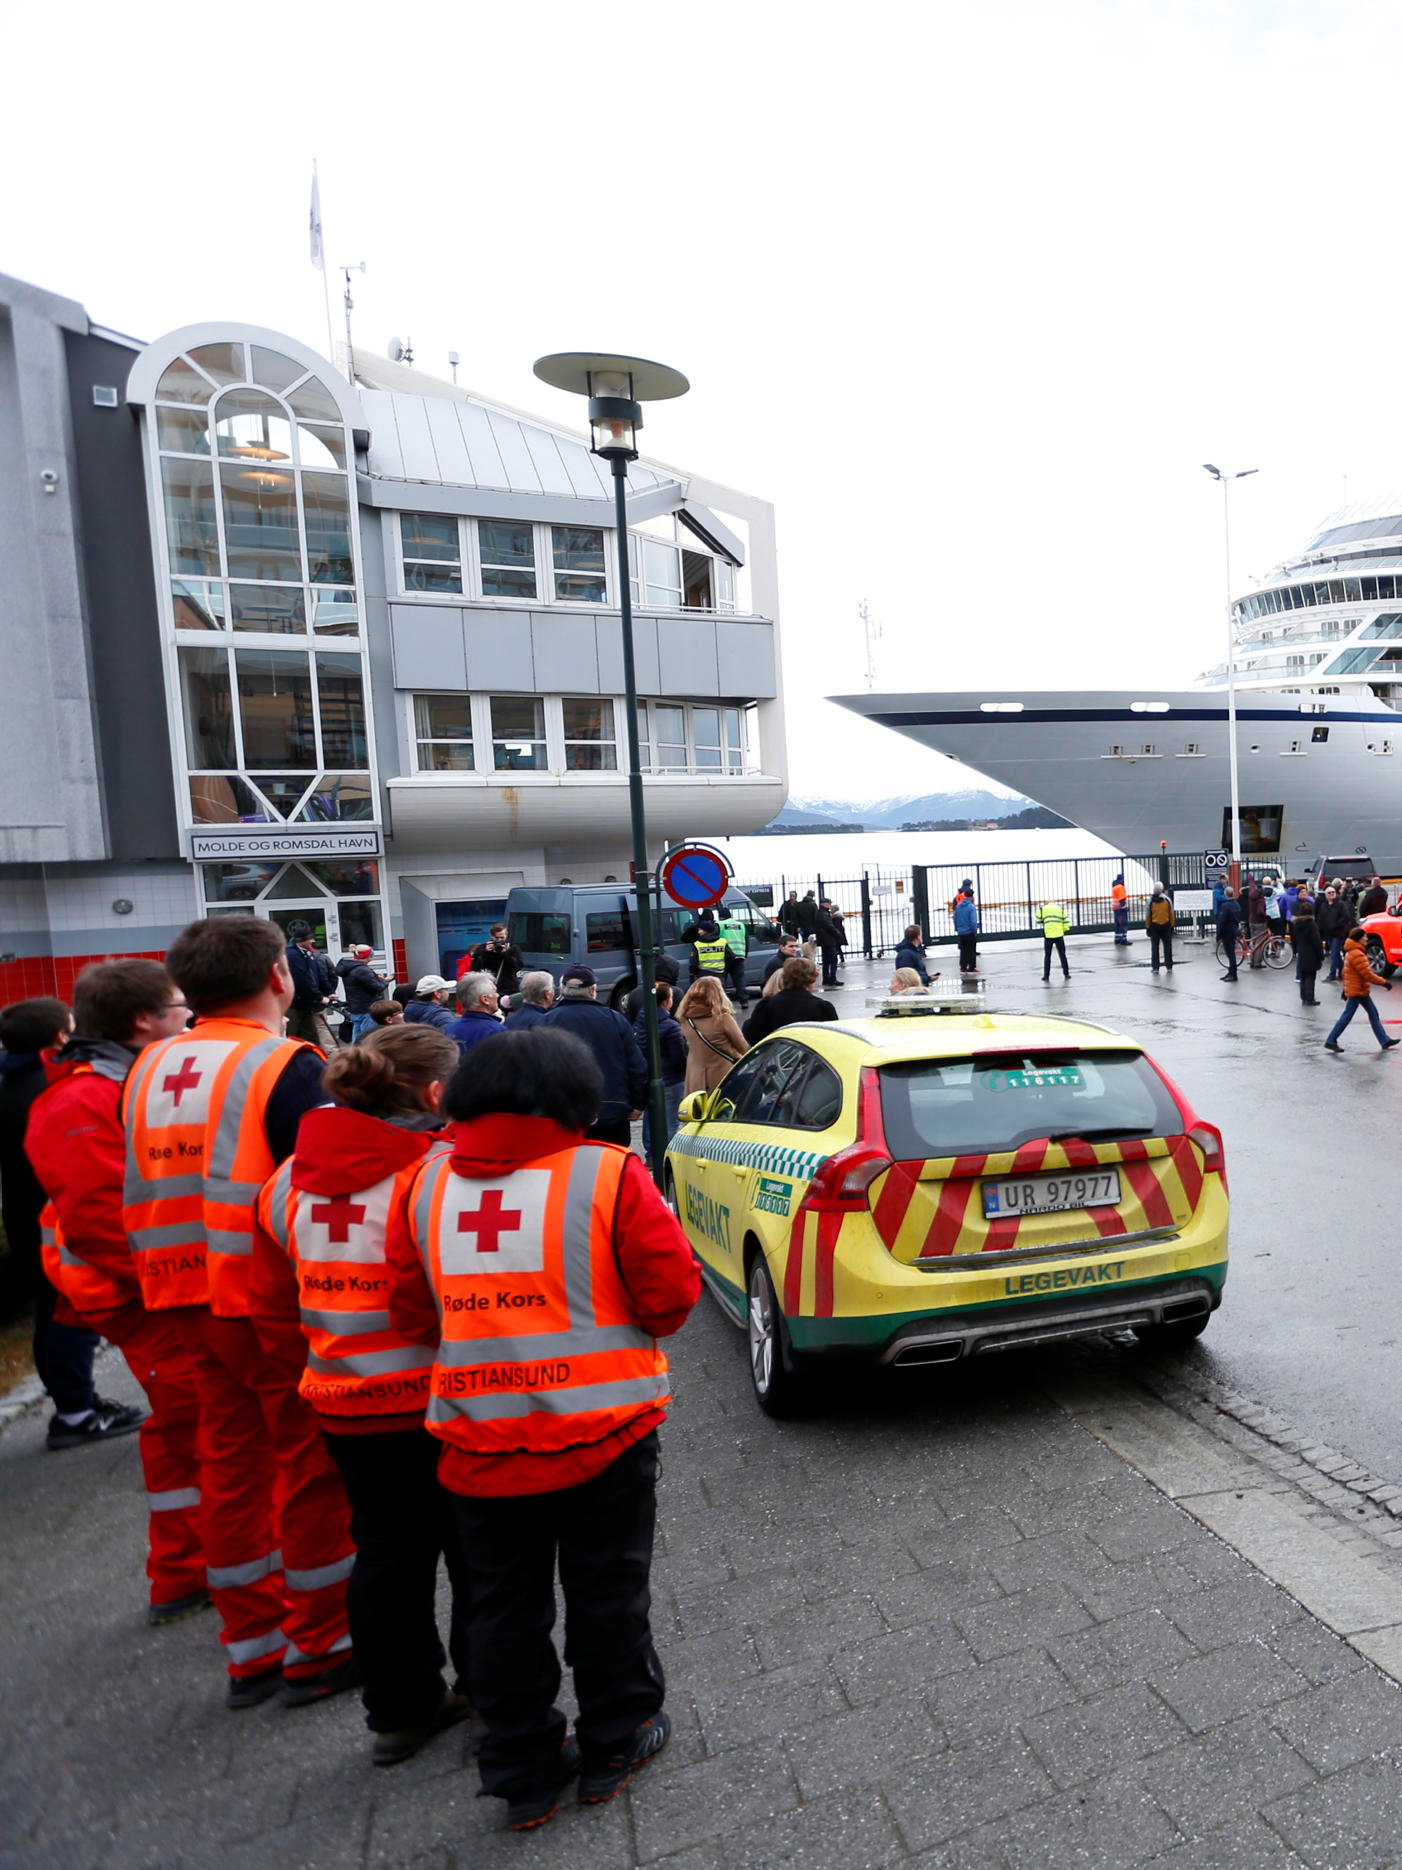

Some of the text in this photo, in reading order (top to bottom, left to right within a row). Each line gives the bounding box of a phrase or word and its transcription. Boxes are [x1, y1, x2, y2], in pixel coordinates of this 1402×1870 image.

[198, 838, 373, 852] MOLDE OG ROMSDAL HAVN
[1005, 1176, 1112, 1208] UR 97977
[685, 1180, 732, 1254] LEGEVAKT
[1005, 1261, 1125, 1295] LEGEVAKT
[444, 1292, 547, 1311] Røde Kors
